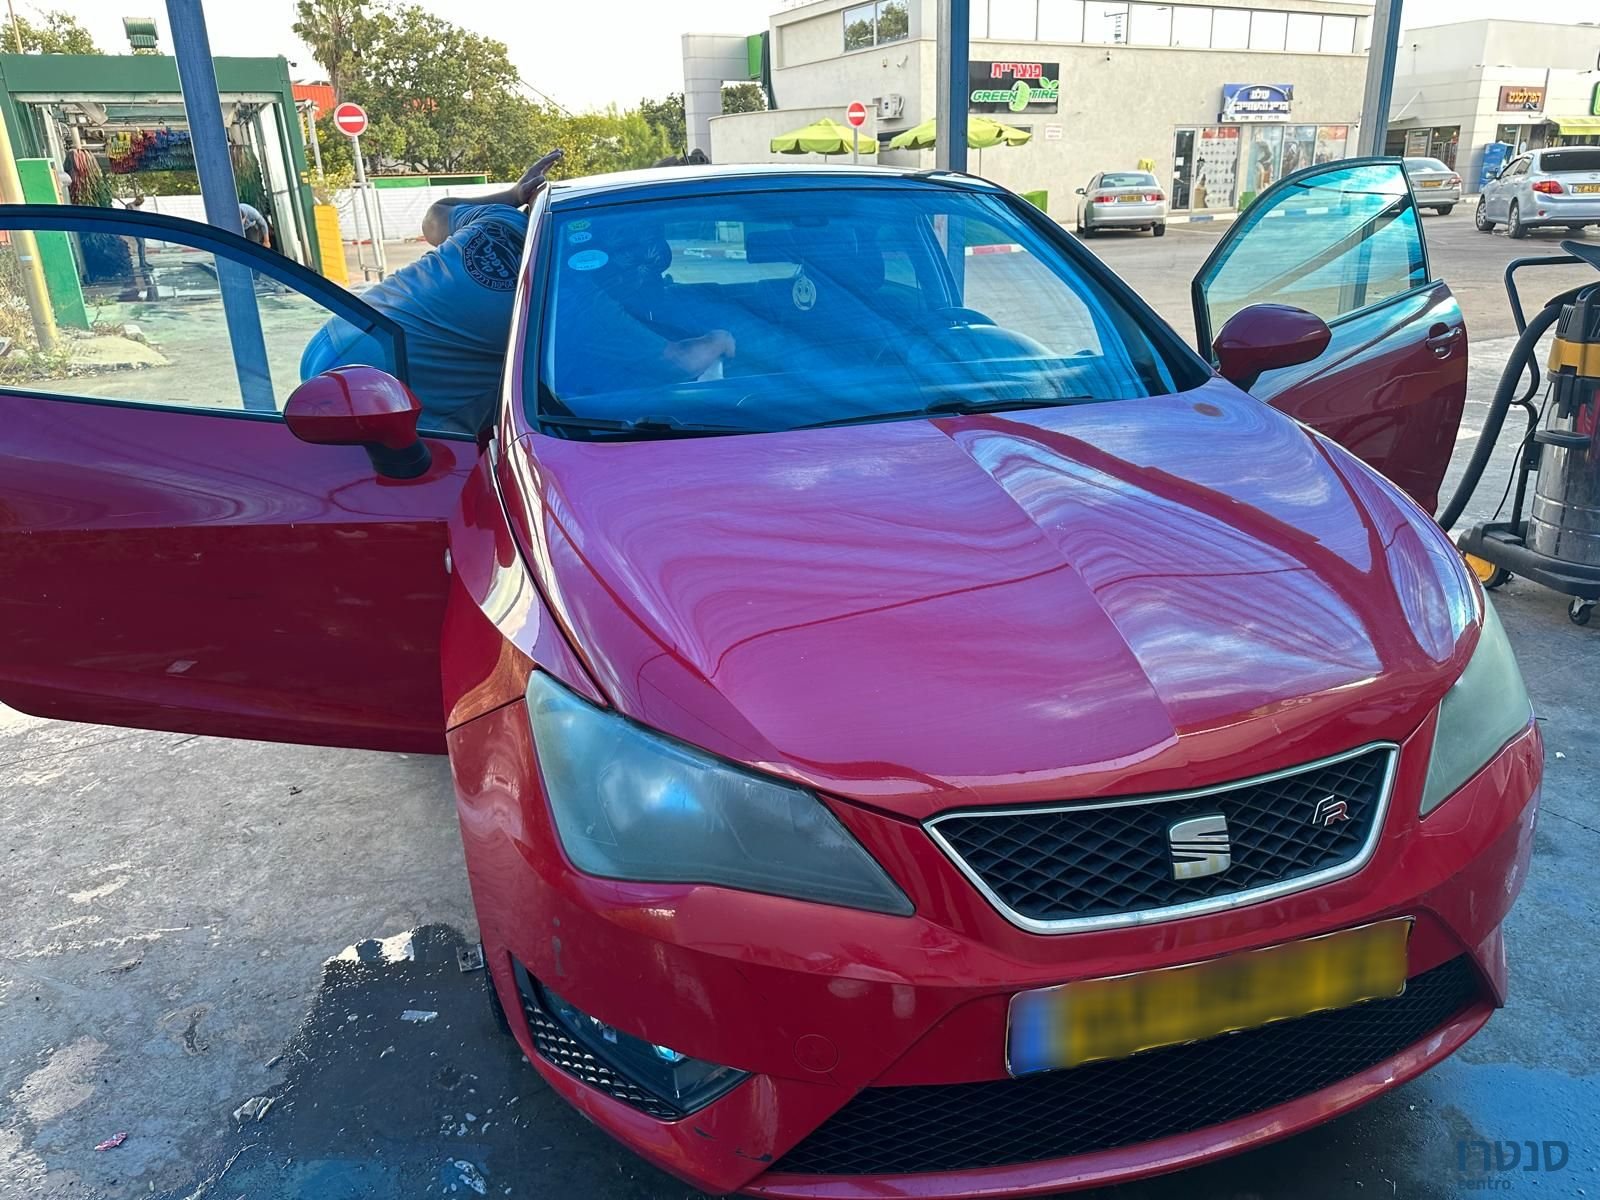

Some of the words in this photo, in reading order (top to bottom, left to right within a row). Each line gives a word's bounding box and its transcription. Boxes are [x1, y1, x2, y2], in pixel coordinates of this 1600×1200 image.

[990, 62, 1042, 79] פנצריית
[971, 90, 1017, 102] GREEN
[1029, 87, 1058, 102] TIRE
